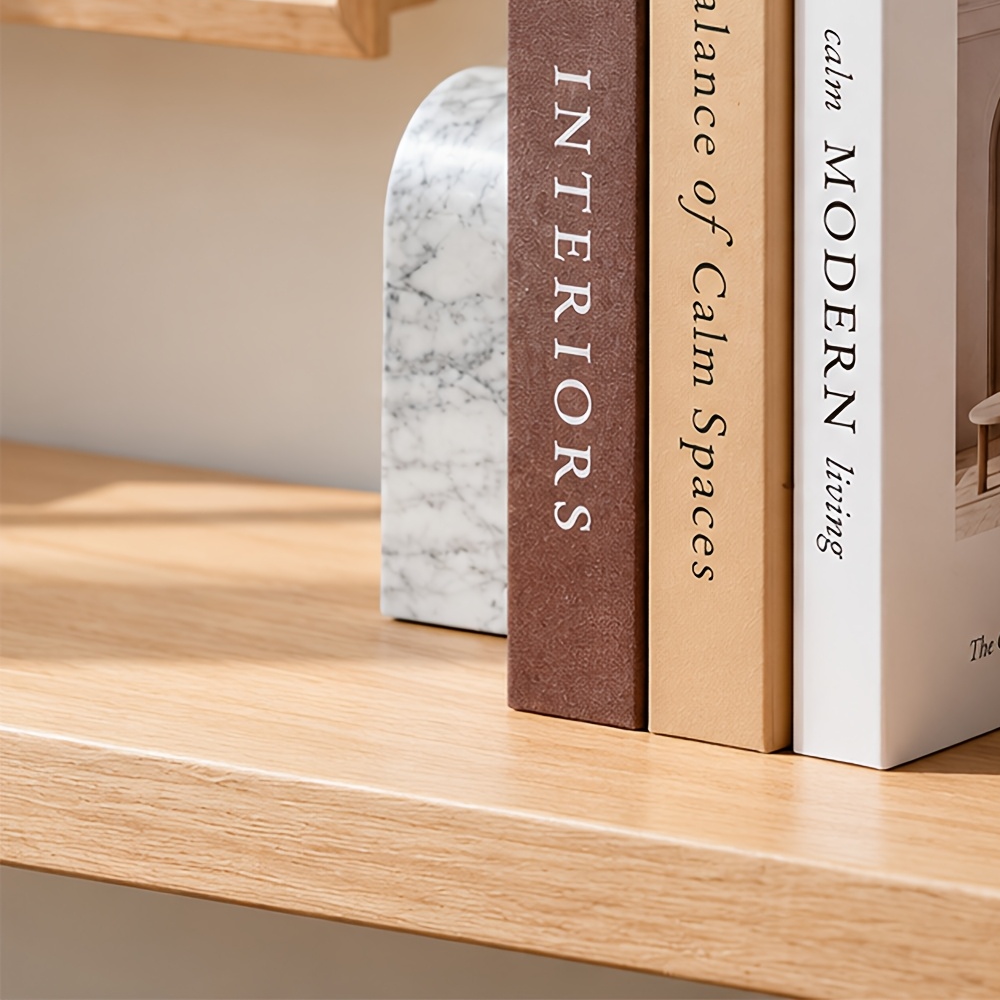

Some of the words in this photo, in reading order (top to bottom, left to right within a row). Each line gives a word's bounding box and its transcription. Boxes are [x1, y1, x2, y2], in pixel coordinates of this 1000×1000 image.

[823, 29, 855, 112] calm
[677, 180, 734, 248] of
[553, 63, 593, 533] INTERIORS
[691, 262, 728, 388] Calm
[822, 139, 858, 435] MODERN
[679, 408, 728, 582] Spaces
[816, 456, 856, 560] living
[969, 635, 995, 662] The
